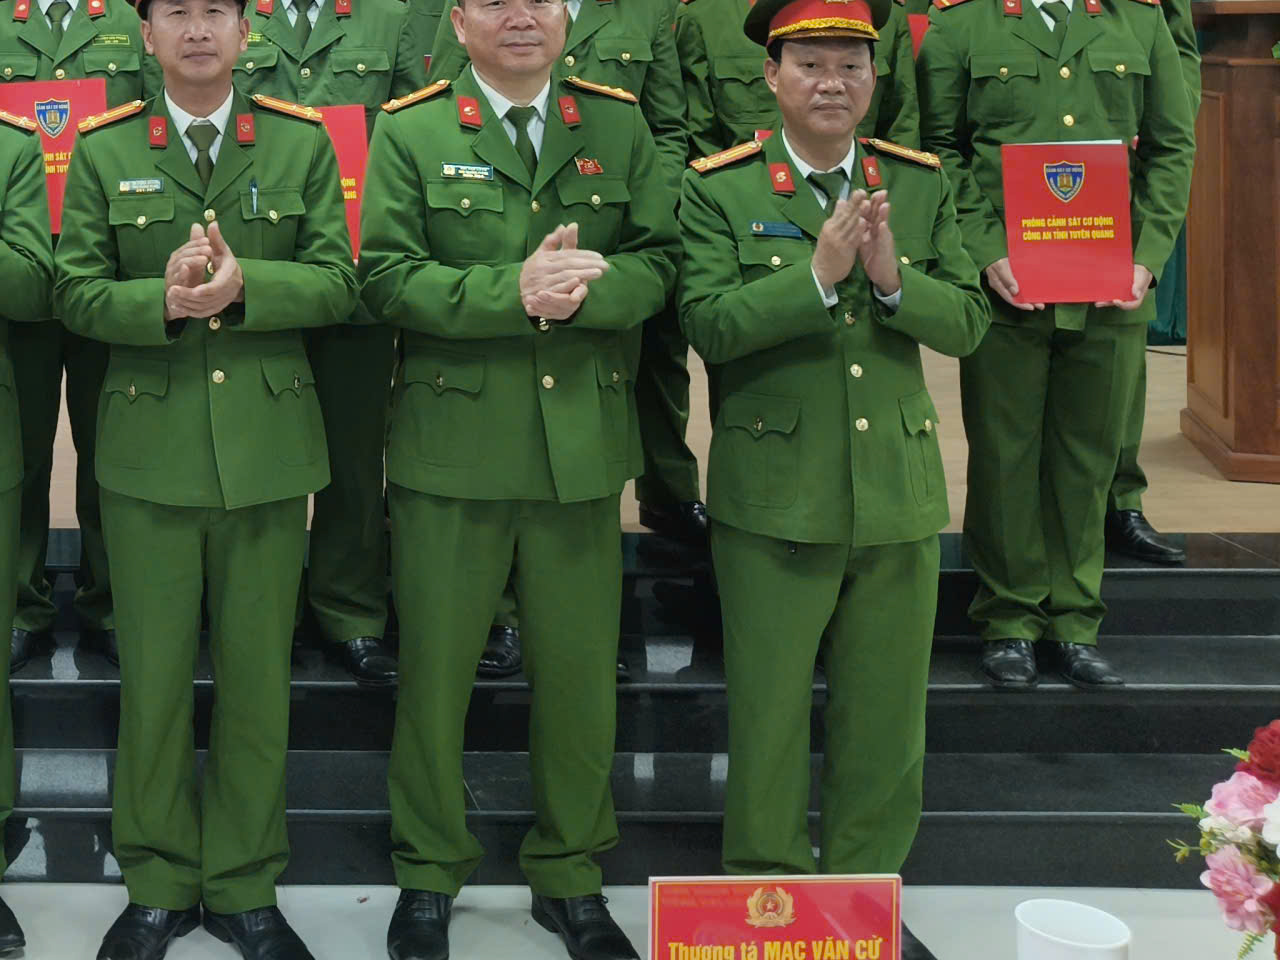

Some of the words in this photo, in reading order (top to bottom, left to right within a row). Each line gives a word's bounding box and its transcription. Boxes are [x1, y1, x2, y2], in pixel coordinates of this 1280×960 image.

[1022, 217, 1046, 228] PHÒNG
[1047, 214, 1066, 227] CẢNH
[1068, 216, 1082, 227] SÁT
[1083, 216, 1093, 226] CƠ
[1023, 230, 1041, 240] CÔNG
[1042, 231, 1052, 240] AN
[1069, 229, 1090, 239] TUYÊN
[1091, 230, 1115, 240] QUANG
[741, 941, 758, 960] tá
[812, 936, 849, 960] VĂN
